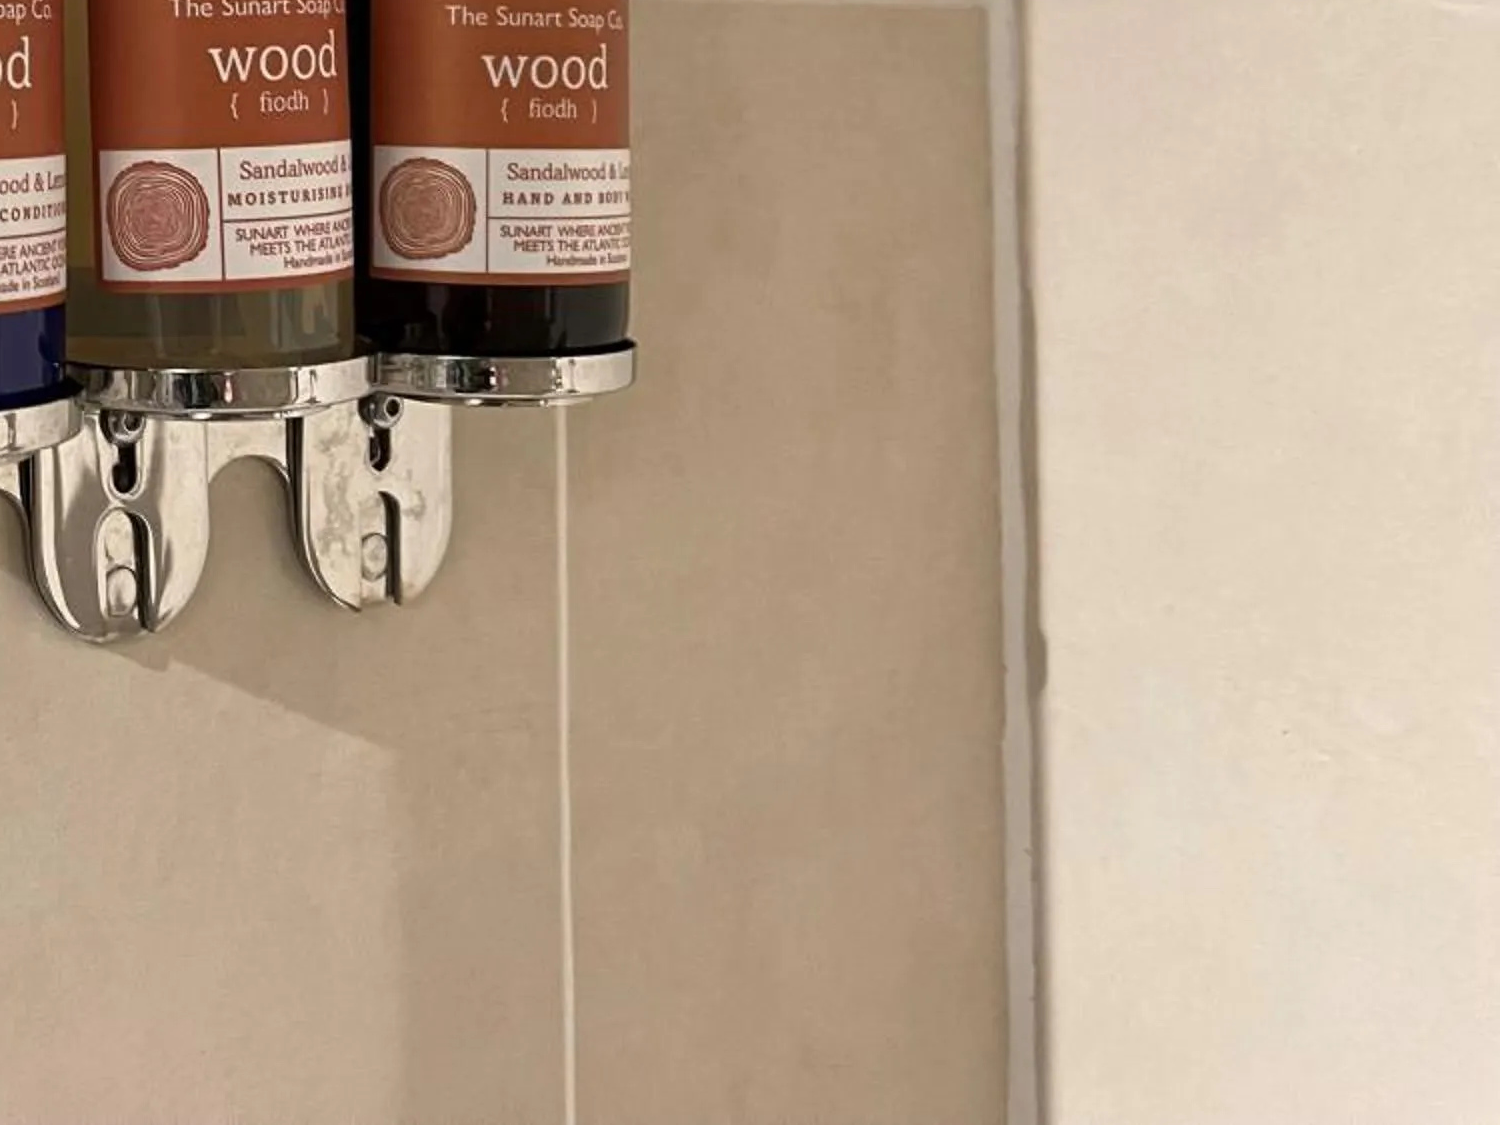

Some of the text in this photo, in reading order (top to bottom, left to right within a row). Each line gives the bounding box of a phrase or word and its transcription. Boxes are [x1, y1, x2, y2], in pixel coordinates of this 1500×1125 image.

[445, 4, 488, 26] The
[496, 5, 562, 27] Sunart
[568, 6, 604, 34] Soap
[208, 28, 337, 84] wood
[481, 43, 608, 90] wood
[260, 89, 309, 113] fiodh
[529, 98, 577, 119] fiodh
[240, 155, 338, 181] Sandalwood
[507, 161, 606, 181] Sandalwood
[33, 172, 44, 192] &
[227, 185, 342, 206] MOISTURISING
[502, 191, 555, 206] HAND
[562, 192, 593, 206] AND
[235, 225, 289, 242] SUNART
[293, 222, 331, 236] WHERE
[500, 225, 553, 239] SUNART
[557, 225, 596, 238] WHERE
[250, 241, 290, 257] MEETS
[295, 239, 317, 253] THE
[513, 239, 554, 253] MEETS
[558, 239, 581, 252] THE
[1, 258, 50, 276] ATLANTIC
[22, 278, 31, 292] in
